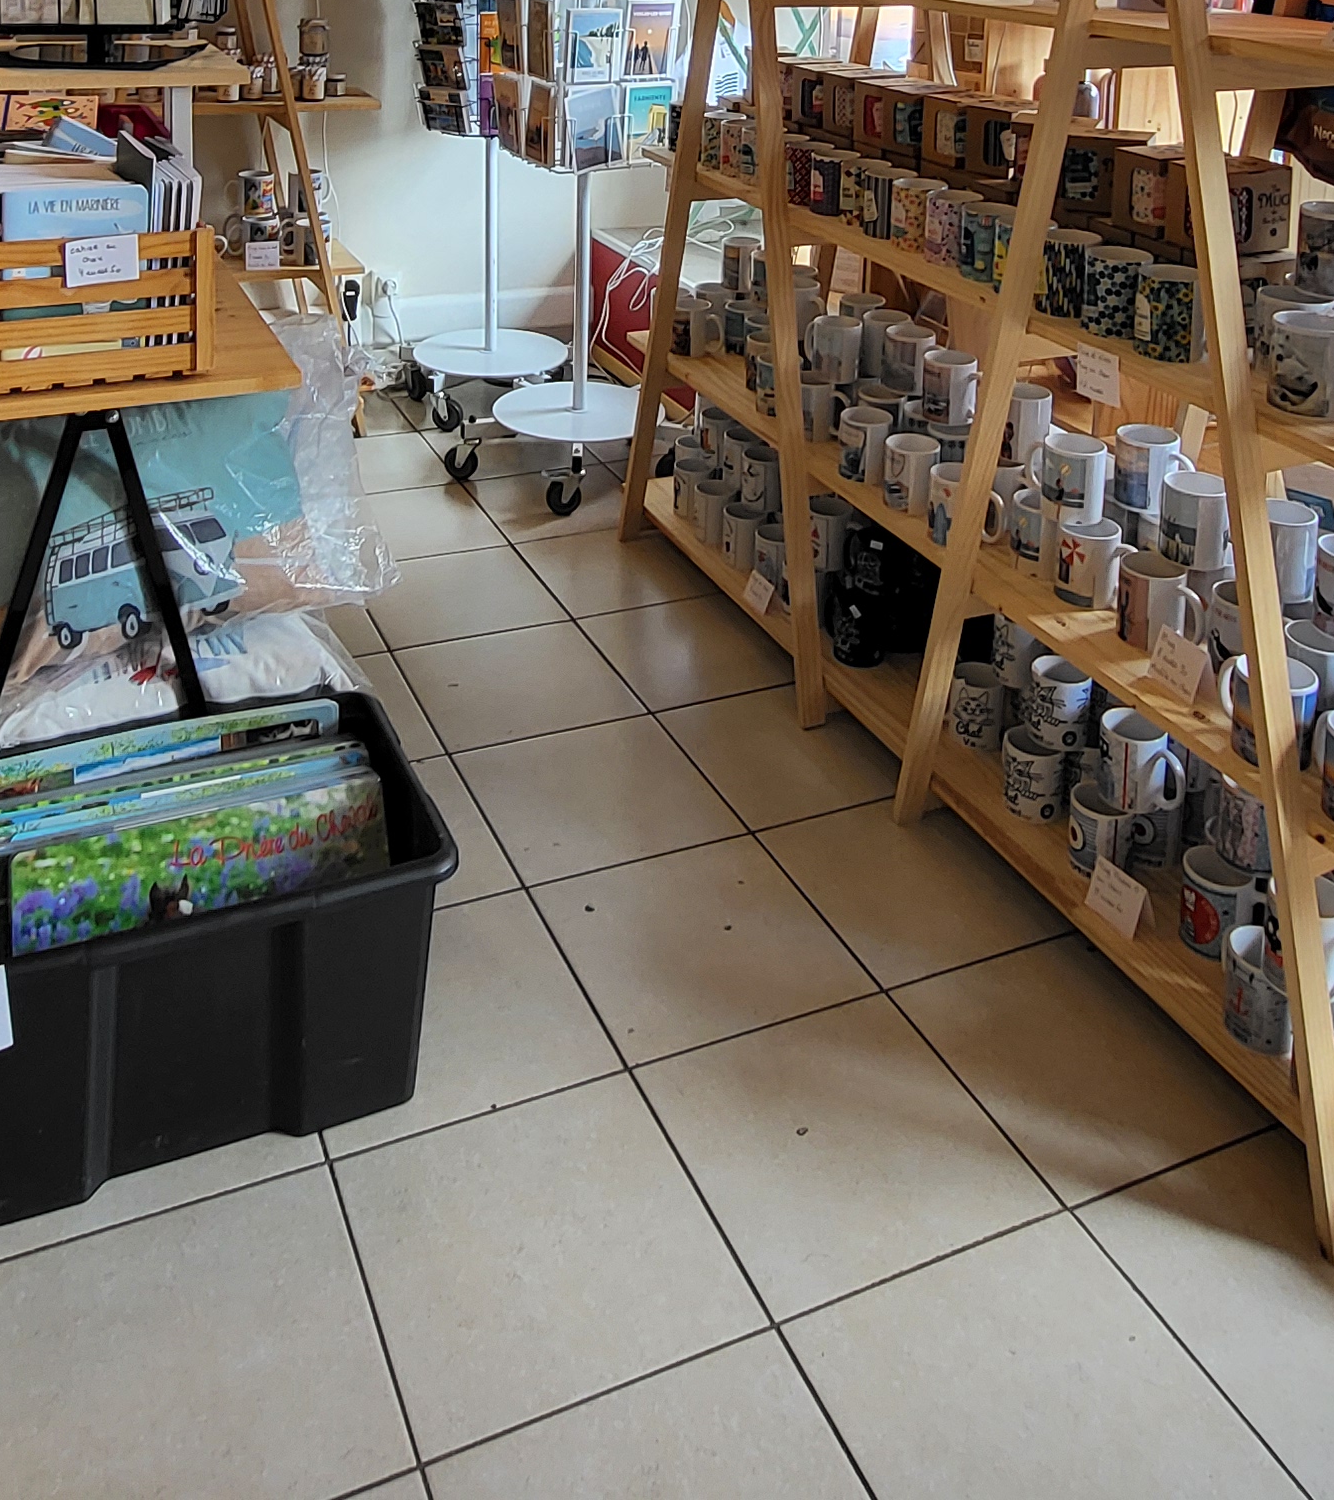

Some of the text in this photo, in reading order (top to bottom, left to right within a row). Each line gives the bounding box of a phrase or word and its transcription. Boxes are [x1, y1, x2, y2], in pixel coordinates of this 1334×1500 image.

[28, 201, 40, 215] LA
[44, 200, 57, 214] VIE
[60, 199, 73, 213] EN
[170, 839, 208, 868] La
[288, 821, 314, 851] du
[316, 795, 380, 843] Cheval
